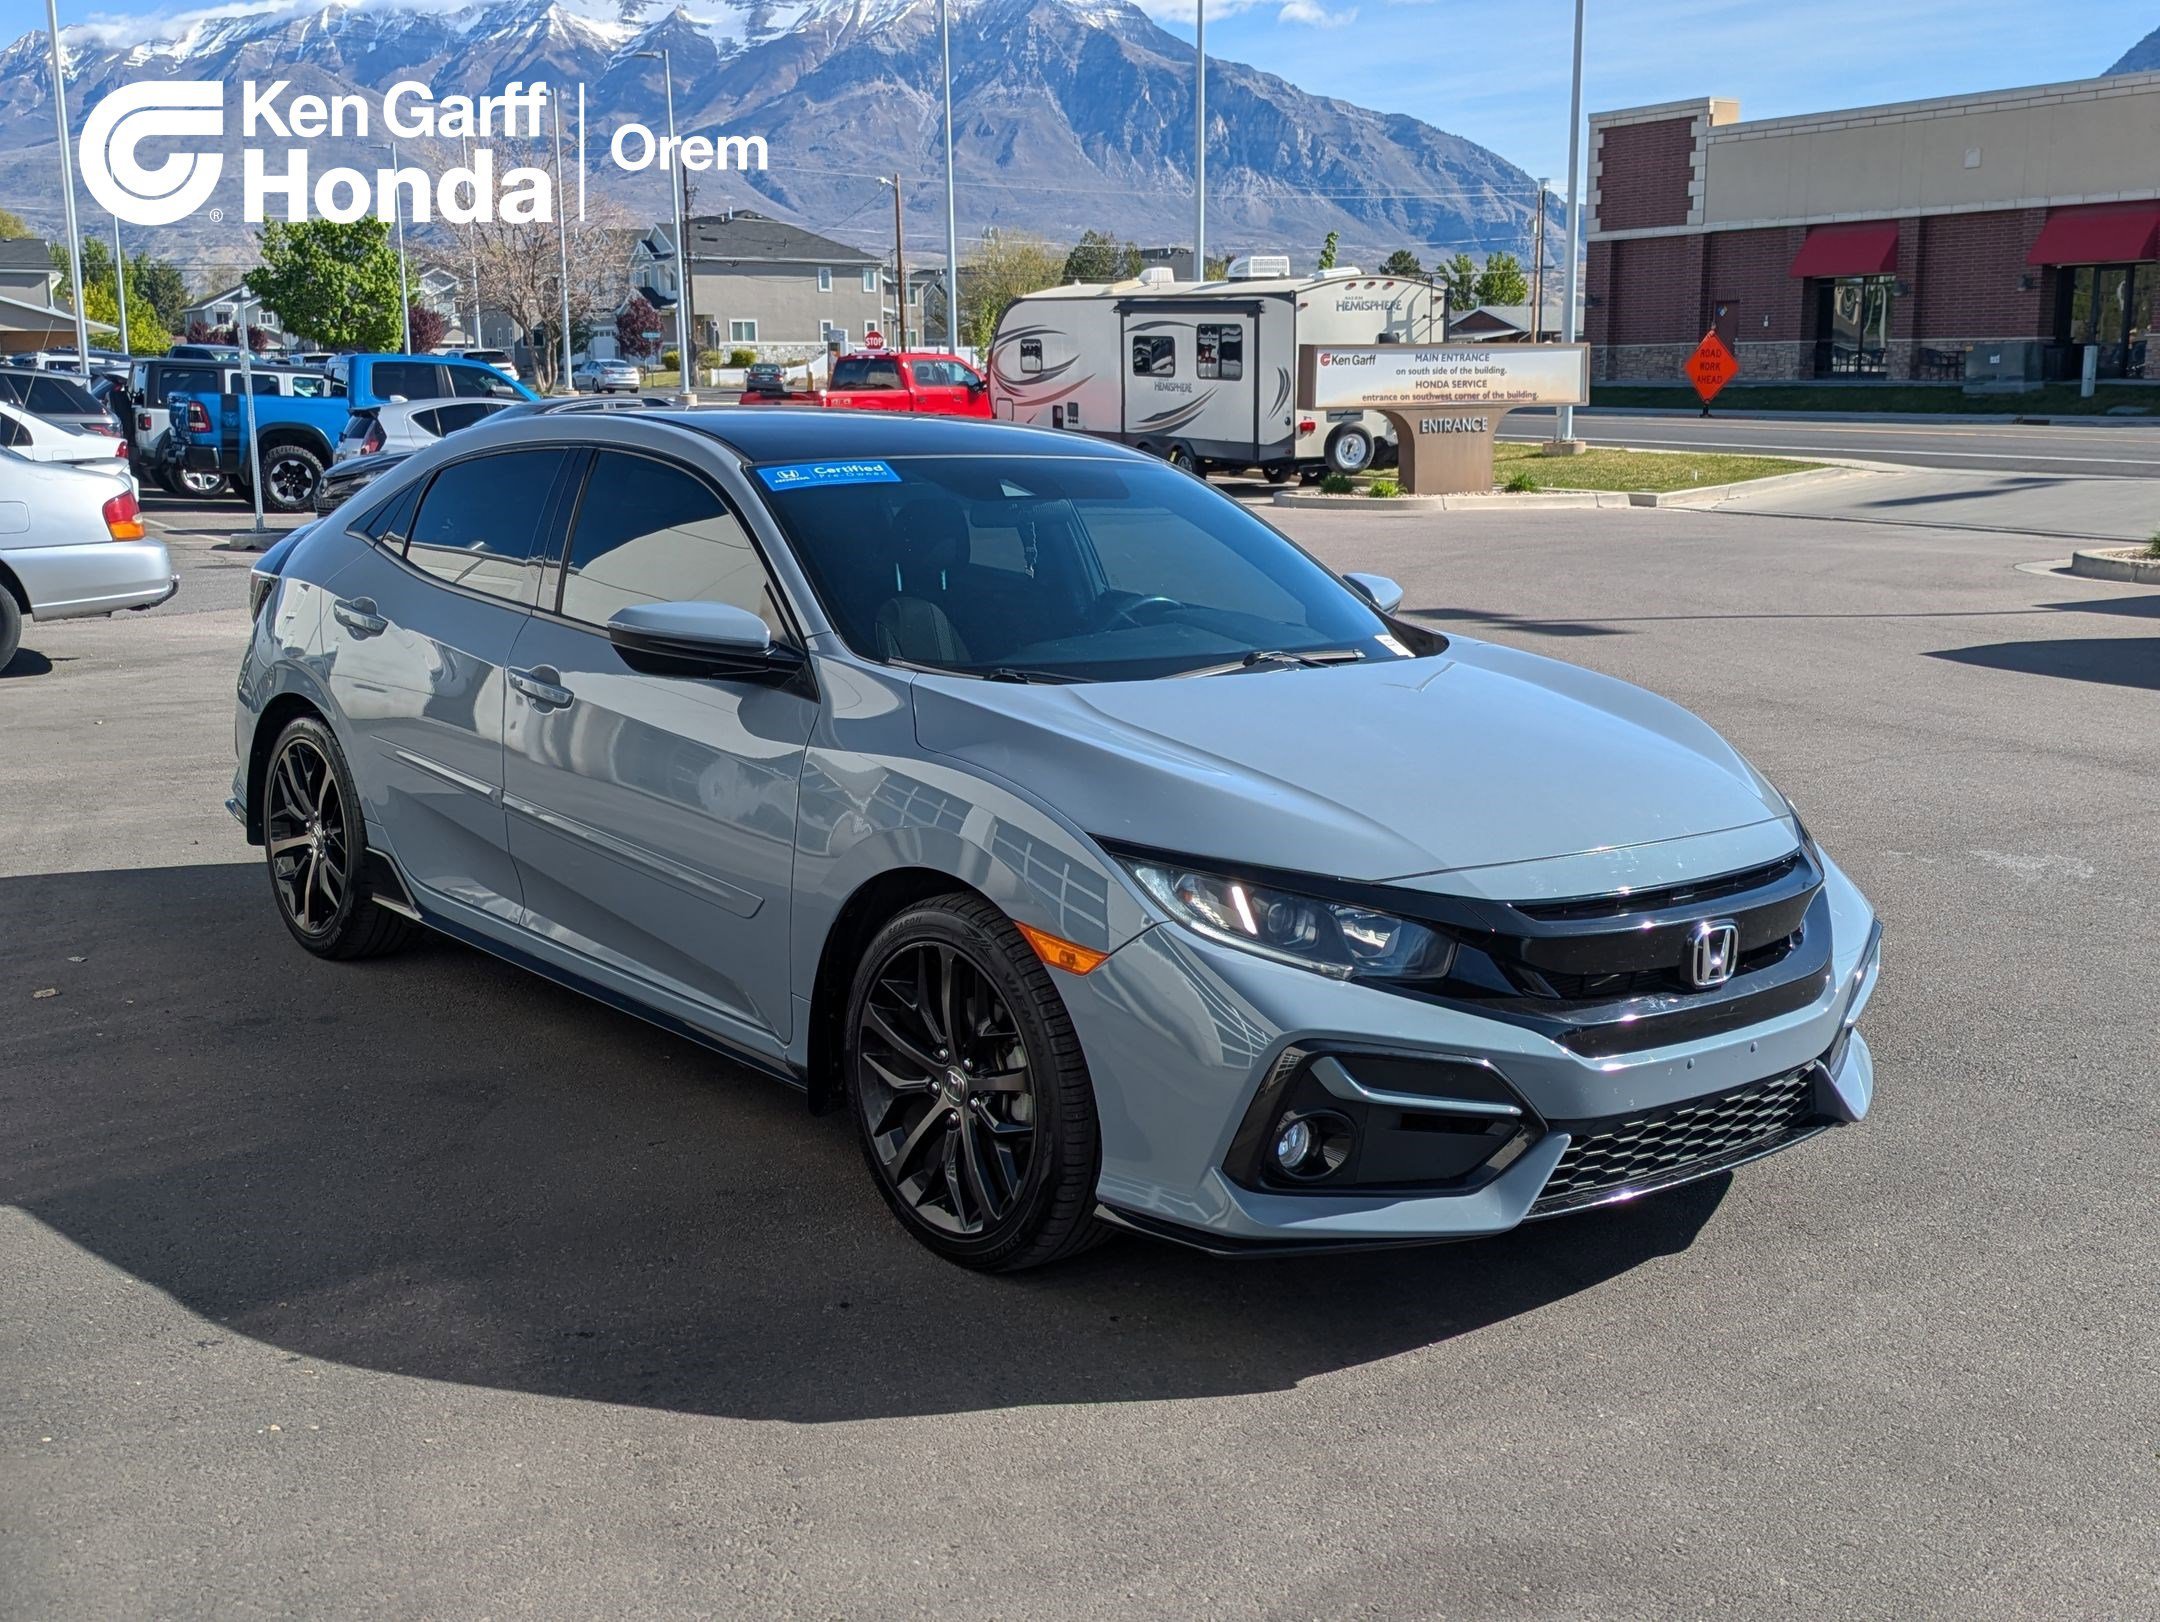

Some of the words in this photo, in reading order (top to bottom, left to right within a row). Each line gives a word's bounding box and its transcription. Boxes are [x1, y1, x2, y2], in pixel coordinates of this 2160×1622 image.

[1335, 300, 1402, 312] HEMISPHERE
[865, 337, 883, 346] STOP
[1414, 353, 1439, 363] MAIN
[1441, 353, 1490, 362] ENTRANCE
[1700, 349, 1722, 358] ROAD
[1331, 354, 1350, 366] Ken
[1352, 354, 1377, 366] Garff
[1395, 368, 1406, 376] on
[1408, 366, 1430, 375] south
[1432, 366, 1448, 375] side
[1450, 366, 1459, 375] of
[1460, 366, 1473, 375] the
[1474, 366, 1508, 376] building.
[1699, 362, 1721, 371] WORK
[1415, 380, 1450, 389] HONDA
[1451, 379, 1488, 388] SERVICE
[1697, 376, 1723, 385] AHEAD
[1362, 393, 1398, 401] entrance
[1399, 393, 1410, 401] on
[1412, 392, 1452, 401] southwest
[1482, 391, 1491, 400] of
[1492, 391, 1505, 400] the
[1506, 391, 1539, 401] building.
[1420, 417, 1488, 433] ENTRANCE
[814, 464, 884, 474] Certified
